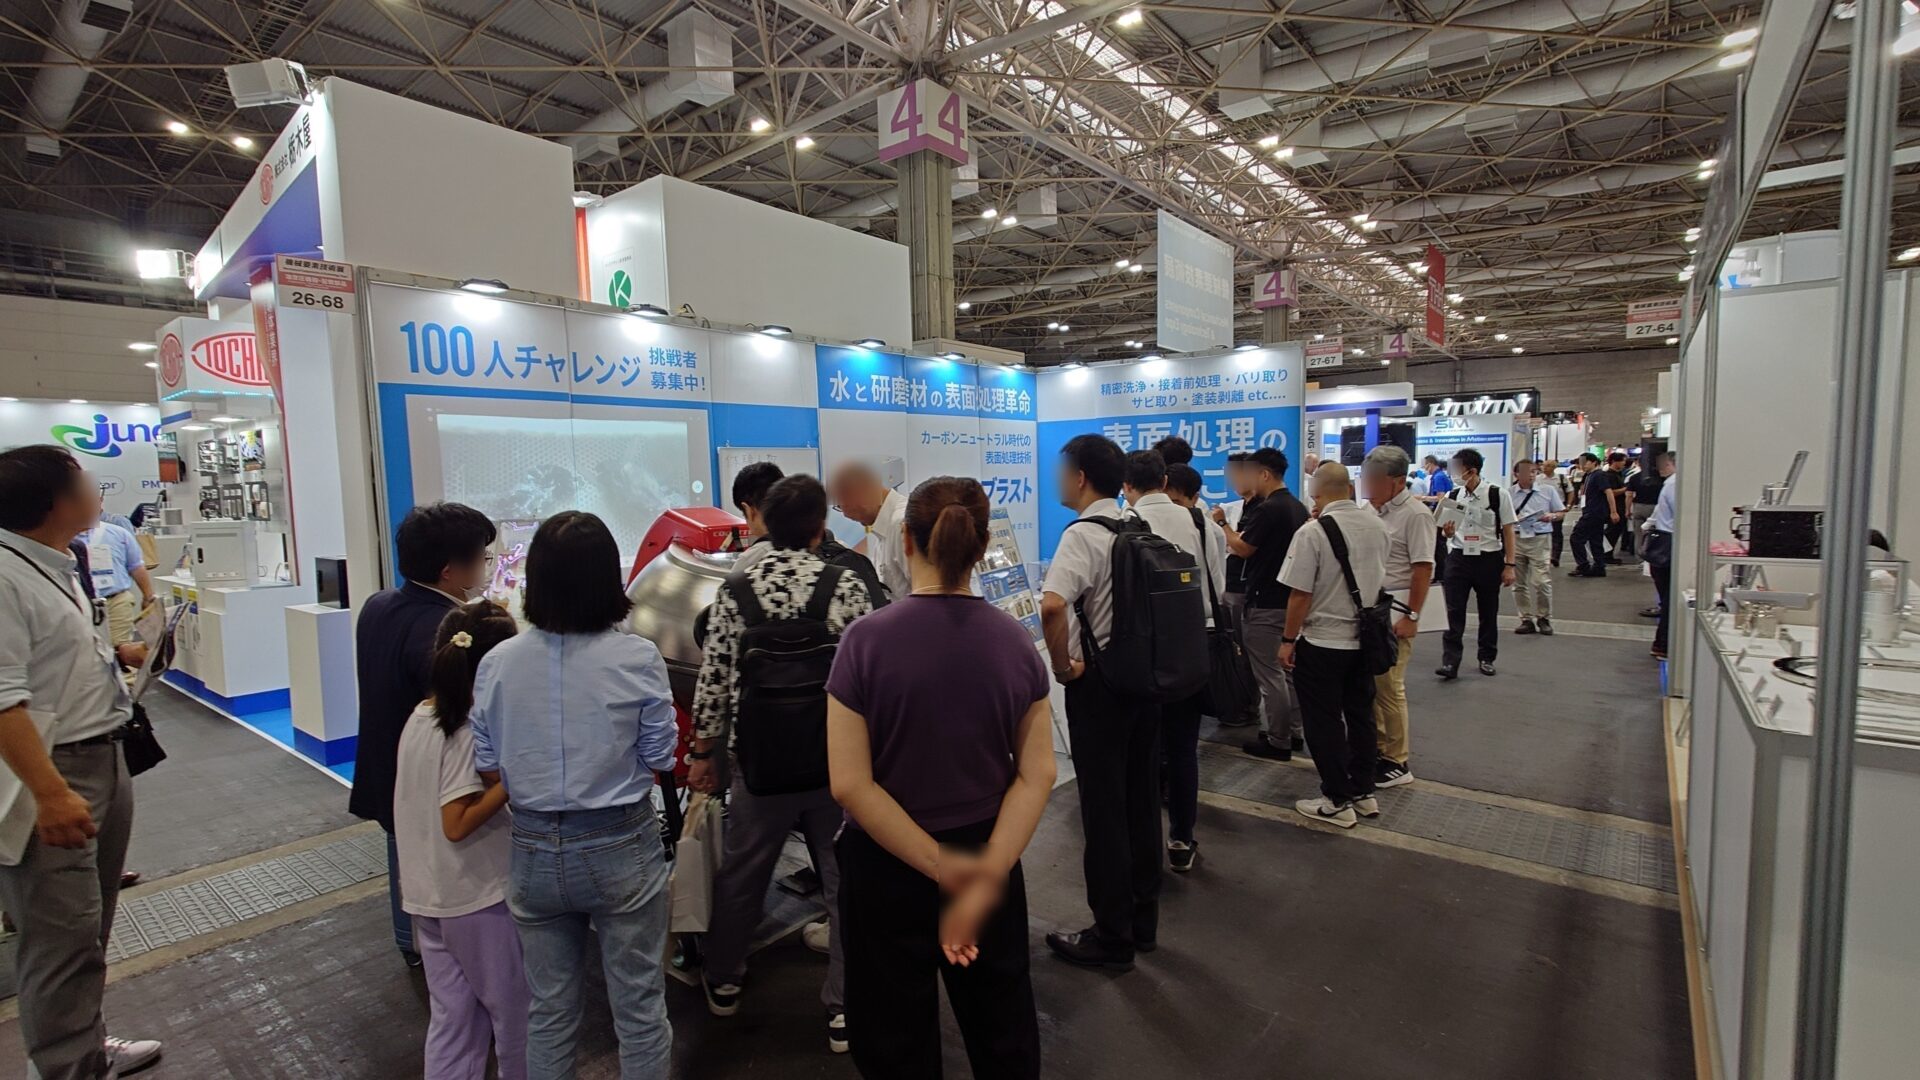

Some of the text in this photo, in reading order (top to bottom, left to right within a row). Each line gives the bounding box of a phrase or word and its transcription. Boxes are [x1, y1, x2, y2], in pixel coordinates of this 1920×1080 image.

[891, 81, 923, 141] 4
[938, 91, 965, 146] 4
[1263, 271, 1285, 300] 4
[292, 291, 344, 309] 26-68
[1635, 323, 1674, 335] 27-64
[648, 346, 697, 369] 挑戦者
[1310, 356, 1336, 366] 27-67
[1100, 369, 1288, 396] 精密洗浄・接着前処理・バリ取り
[829, 370, 1031, 416] 水と研磨材の表面処理革命
[1428, 397, 1532, 417] HIWIN
[1435, 417, 1470, 429] SIM
[921, 430, 1031, 446] カーボンニュートラル時代の
[985, 451, 1032, 465] 表面処理技術
